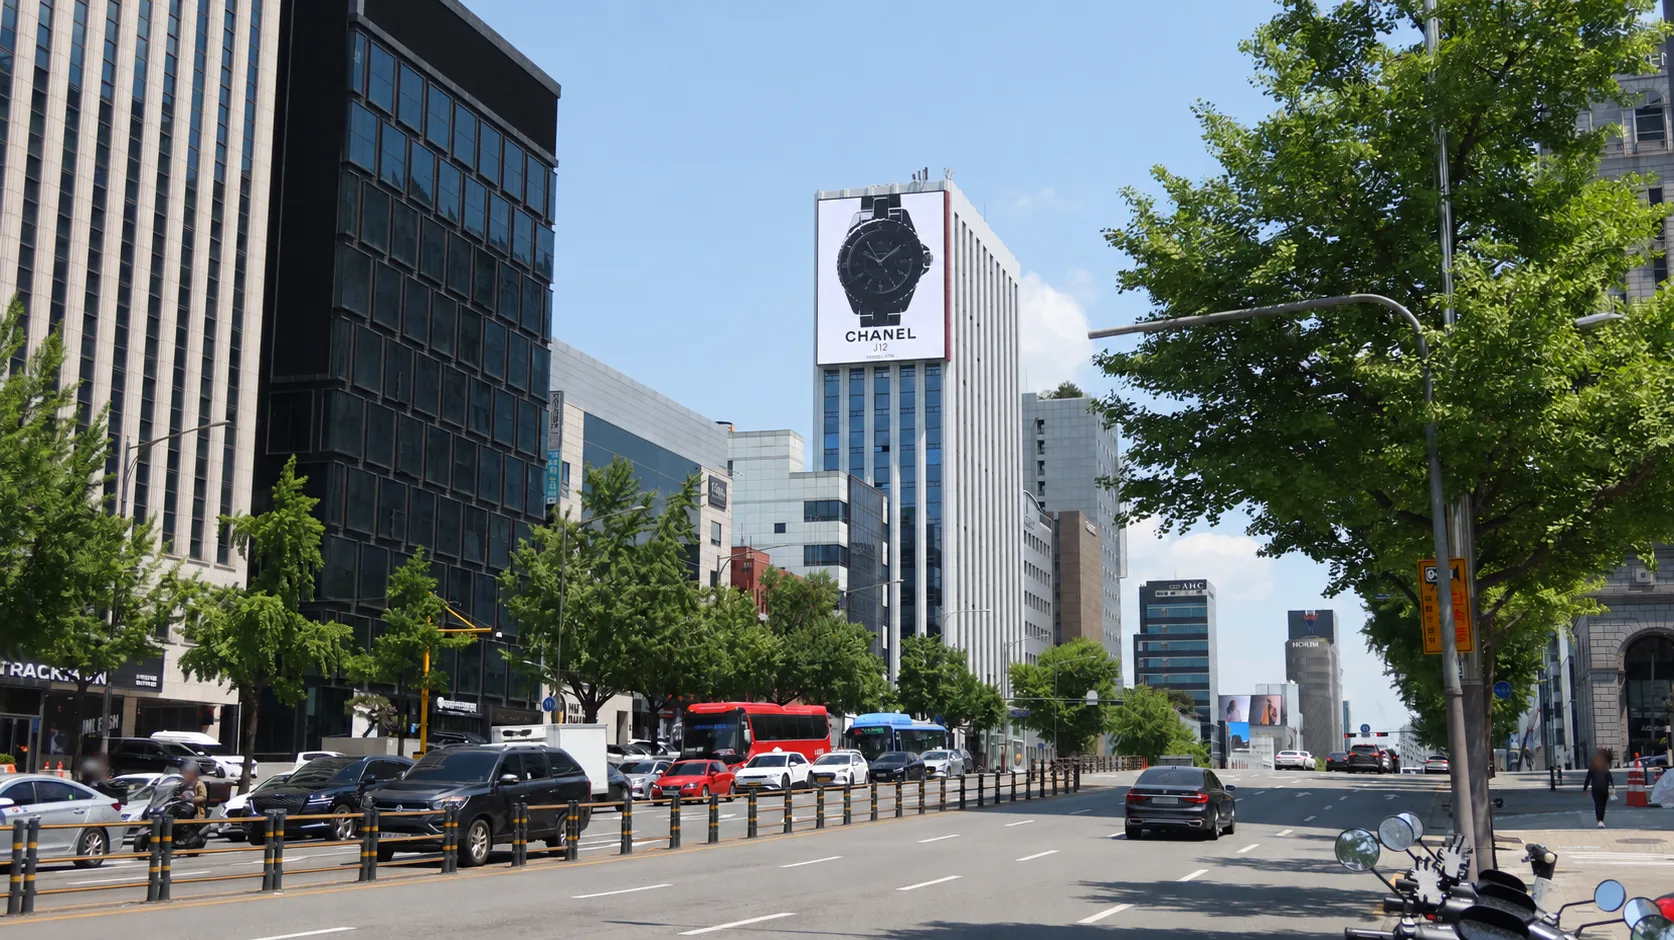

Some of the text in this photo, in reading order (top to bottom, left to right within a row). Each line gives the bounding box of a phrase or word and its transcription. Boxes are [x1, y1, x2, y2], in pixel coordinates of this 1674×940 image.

[846, 328, 916, 342] CHANEL
[873, 343, 888, 352] J12
[1183, 582, 1204, 590] AHC
